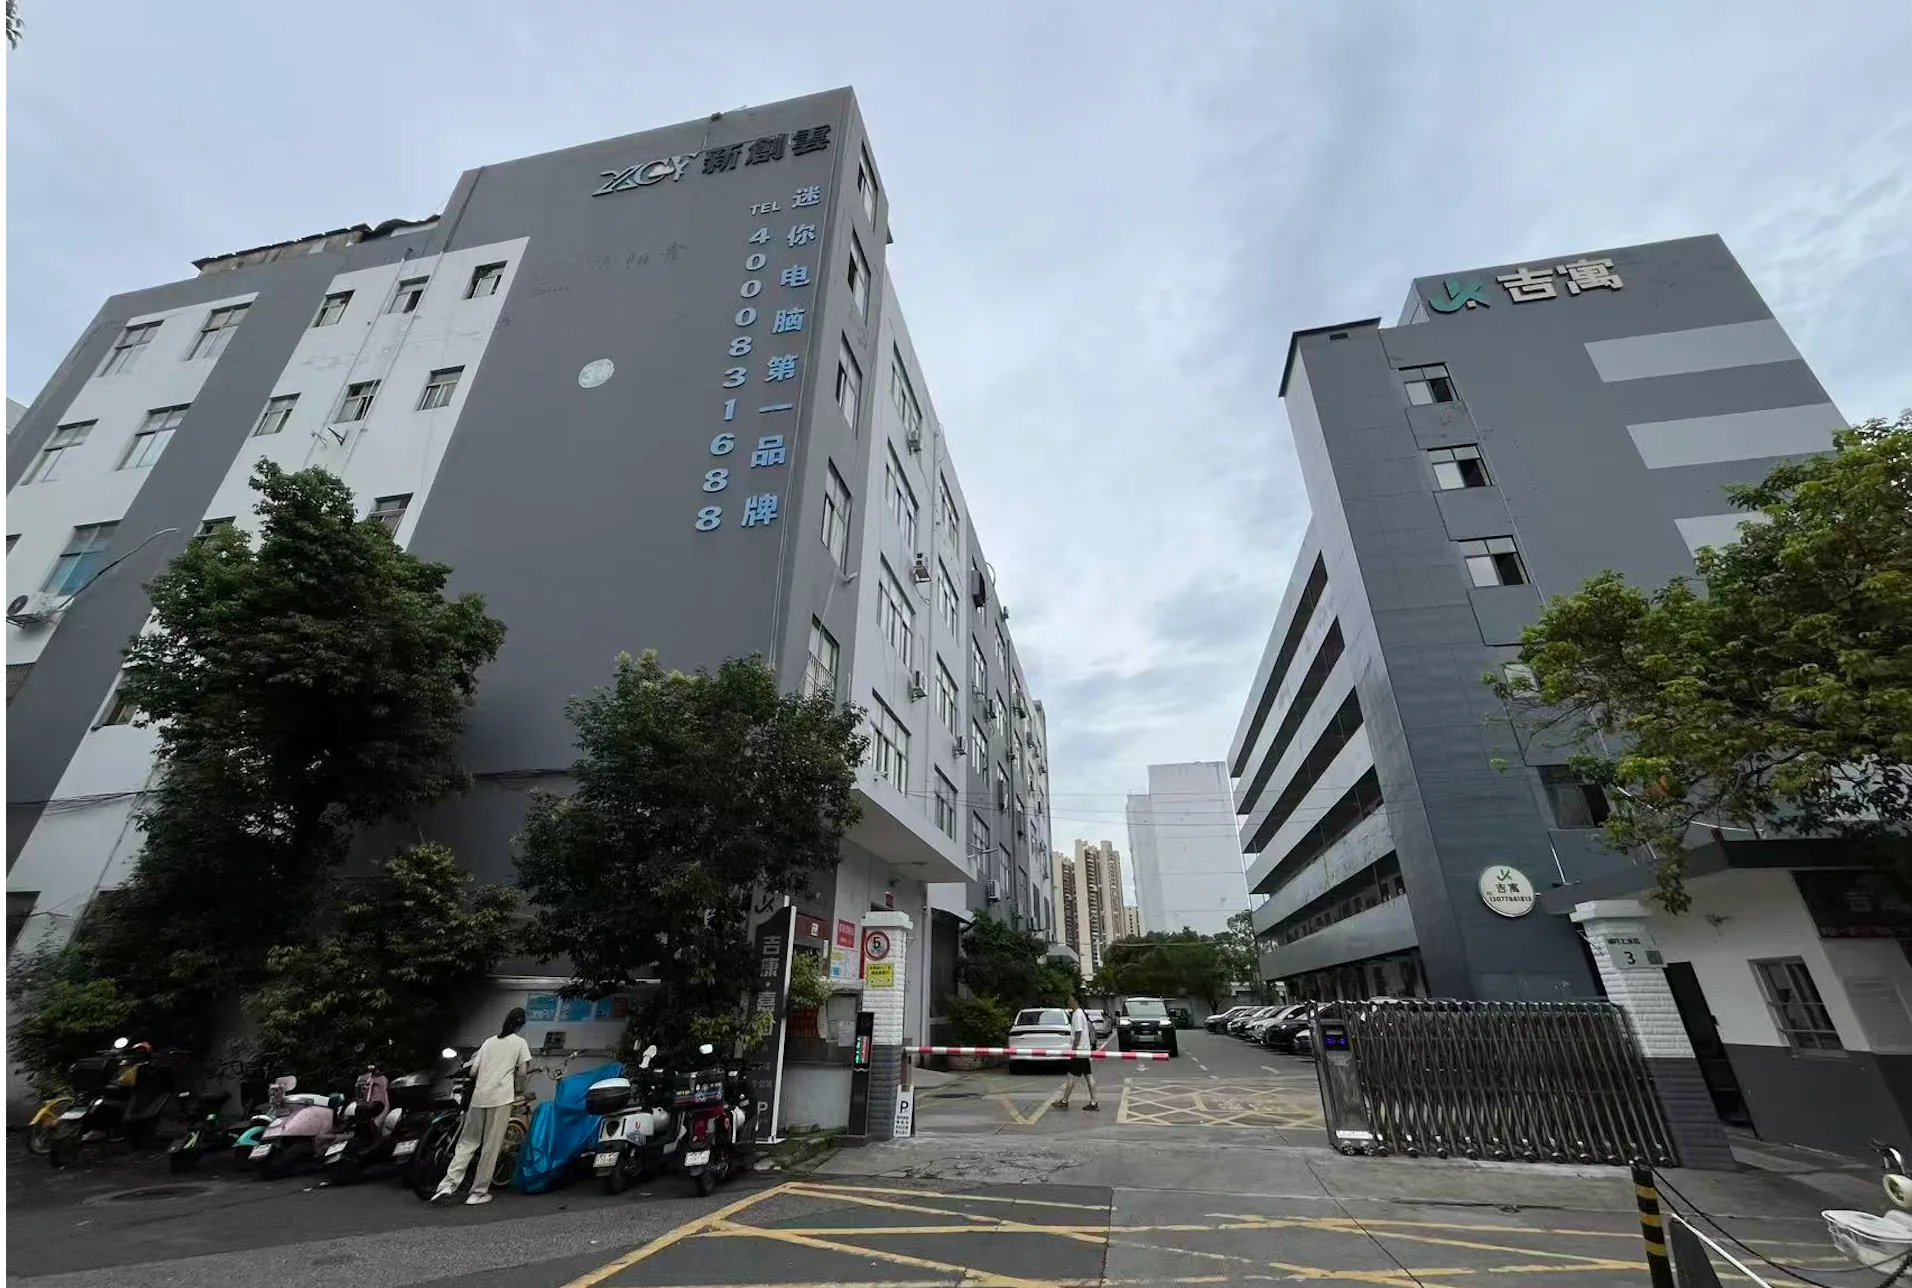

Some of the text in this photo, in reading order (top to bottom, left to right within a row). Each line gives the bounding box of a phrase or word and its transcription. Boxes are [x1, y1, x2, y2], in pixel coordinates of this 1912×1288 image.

[702, 124, 832, 175] 新創雲
[750, 201, 781, 216] TEL
[1496, 258, 1624, 304] 吉寓
[741, 185, 822, 527] 迷你电脑第一品牌
[695, 227, 770, 531] 4000831688
[872, 936, 881, 949] 5
[1624, 951, 1636, 965] 3
[757, 1101, 768, 1115] P
[900, 1101, 909, 1113] P
